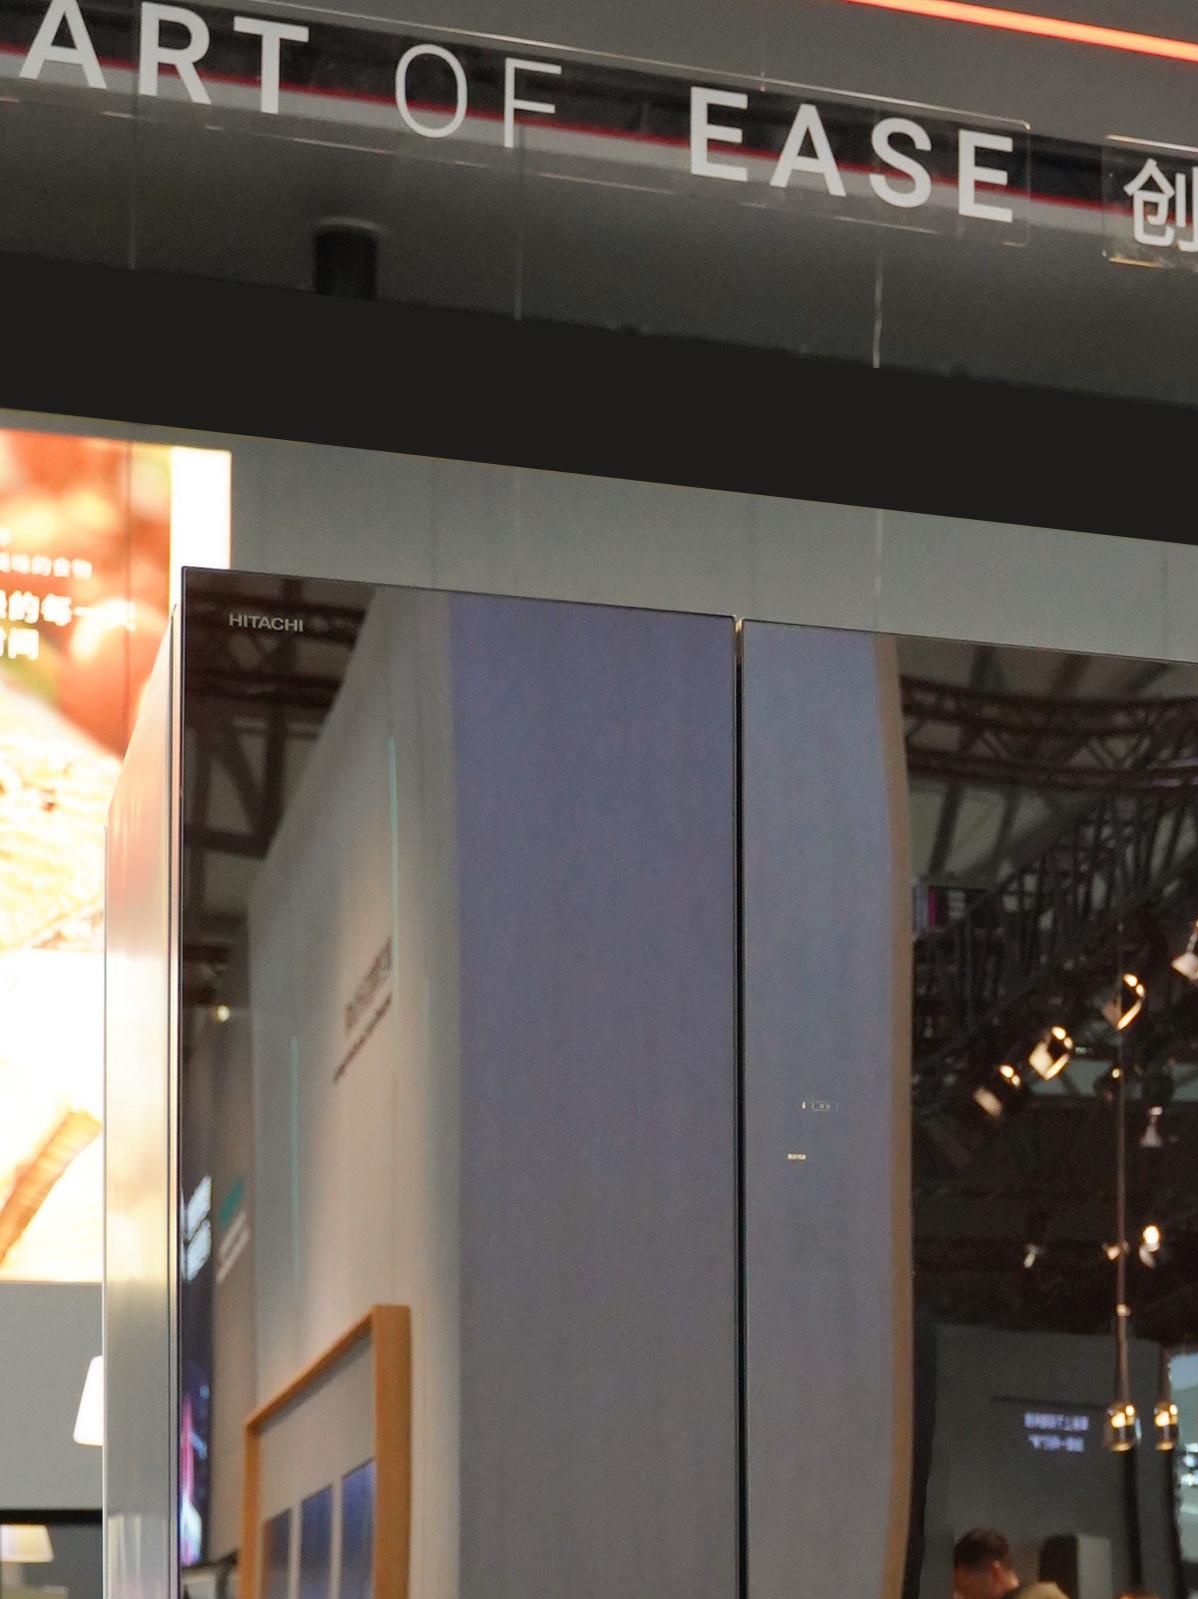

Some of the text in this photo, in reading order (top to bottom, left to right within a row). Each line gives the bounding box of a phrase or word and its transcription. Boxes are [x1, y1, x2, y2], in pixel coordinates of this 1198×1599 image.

[19, 0, 1014, 224] ART OF EASE
[228, 613, 304, 632] HITACHI
